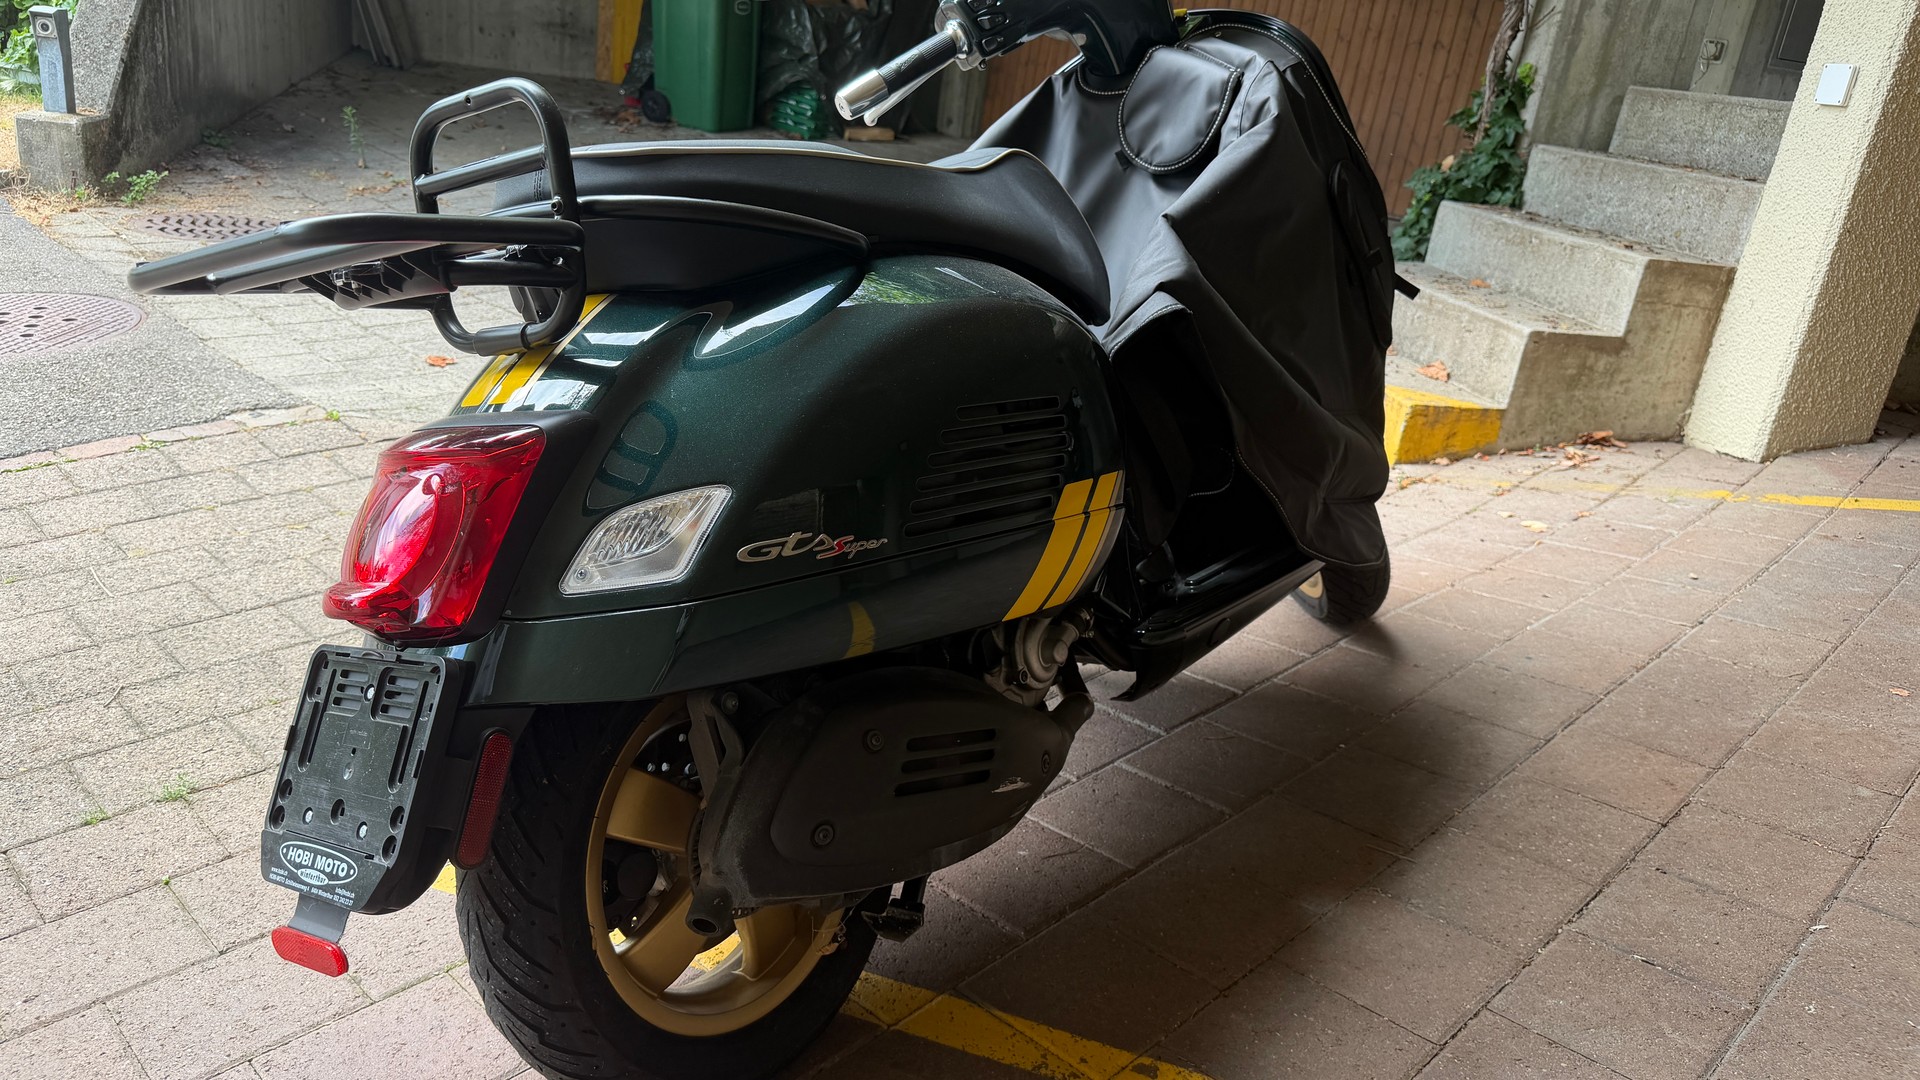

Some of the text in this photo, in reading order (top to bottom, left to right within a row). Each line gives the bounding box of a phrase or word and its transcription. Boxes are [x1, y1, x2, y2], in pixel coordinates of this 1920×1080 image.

[816, 535, 888, 560] Super
[287, 846, 348, 877] HOBI MOTO
